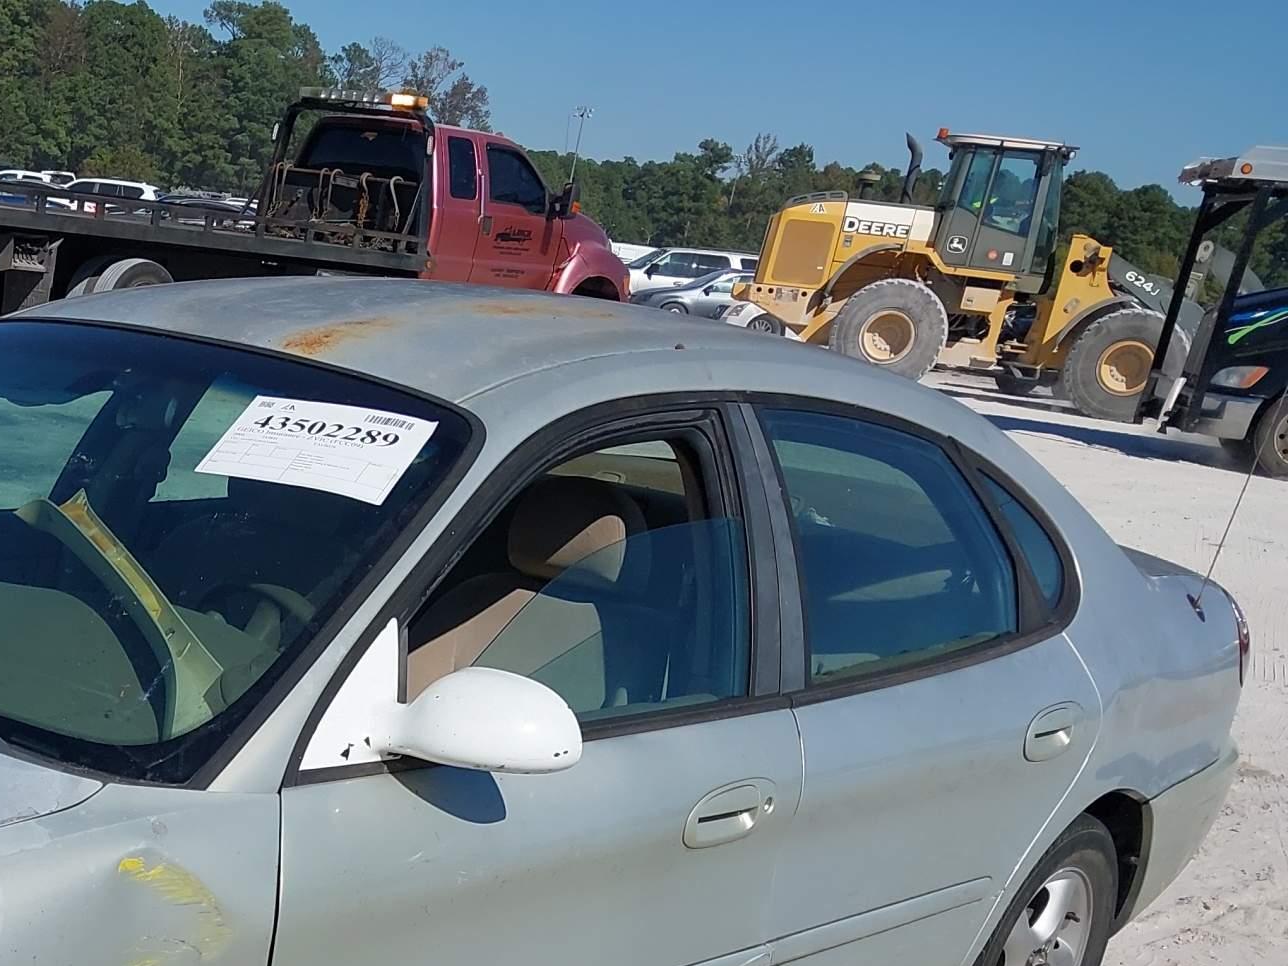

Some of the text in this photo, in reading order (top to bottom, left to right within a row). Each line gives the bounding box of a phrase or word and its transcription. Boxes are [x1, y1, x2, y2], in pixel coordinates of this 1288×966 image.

[843, 216, 911, 239] DEERE
[1125, 270, 1161, 296] 624J
[253, 414, 400, 447] 43502289
